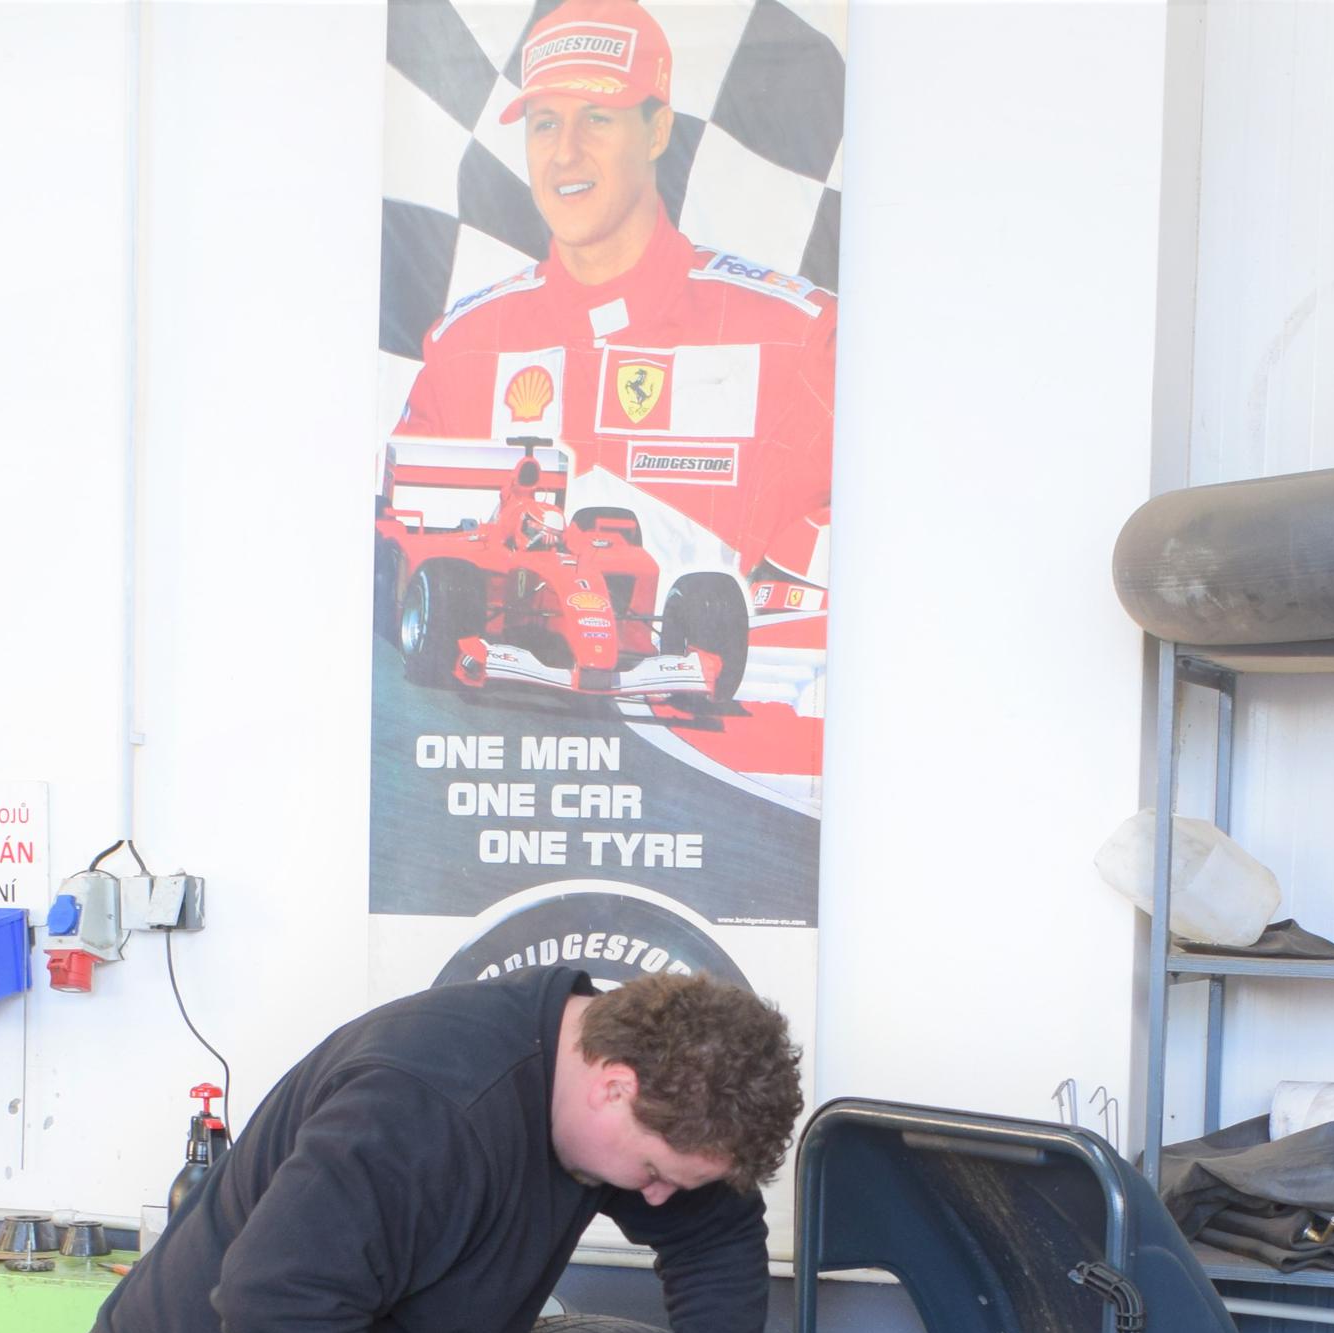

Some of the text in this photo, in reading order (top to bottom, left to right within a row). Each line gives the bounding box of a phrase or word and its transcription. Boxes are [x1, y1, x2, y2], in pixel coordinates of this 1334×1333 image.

[712, 254, 803, 294] FedEx
[634, 453, 732, 472] BRIDGESTONE
[659, 663, 696, 672] FedEx
[416, 736, 620, 771] ONE MAN
[447, 783, 642, 819] ONE CAR
[479, 830, 703, 868] ONE TYRE
